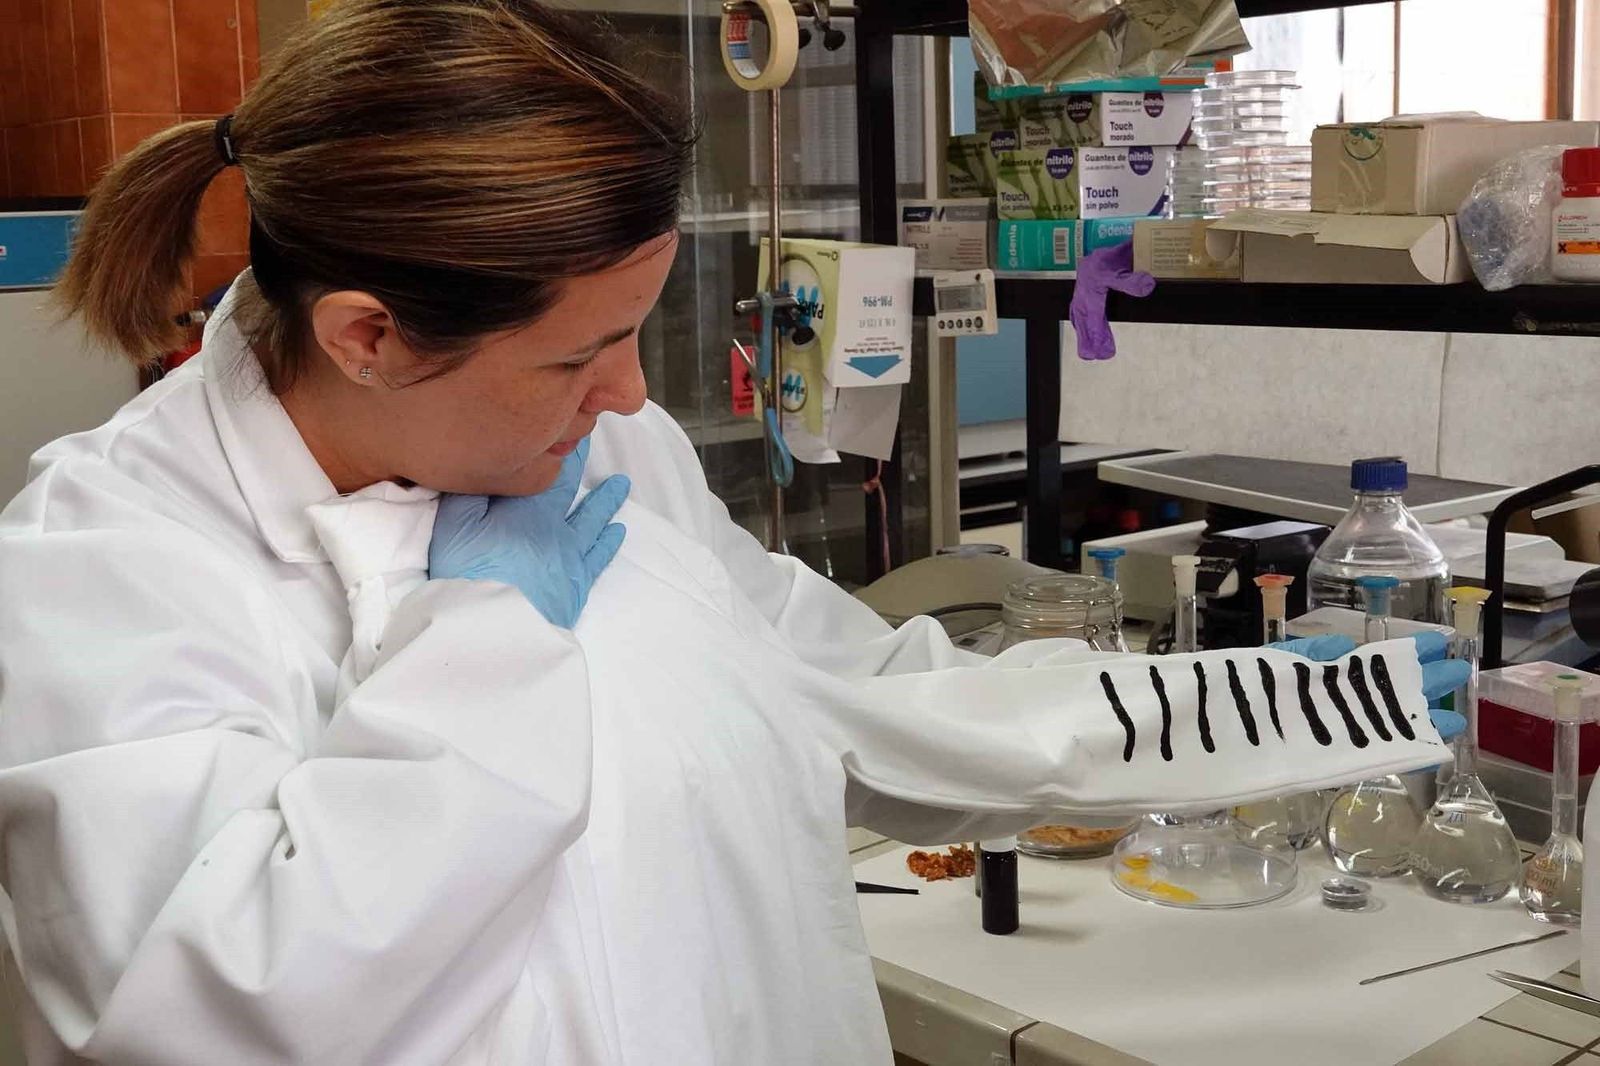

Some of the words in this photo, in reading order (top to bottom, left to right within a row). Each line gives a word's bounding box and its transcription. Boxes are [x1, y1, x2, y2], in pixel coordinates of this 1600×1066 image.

[1110, 121, 1134, 131] Touch
[1110, 133, 1135, 141] morado
[1046, 154, 1074, 165] nitrilo
[1085, 153, 1116, 162] Guantes
[1117, 153, 1126, 161] de
[1128, 151, 1153, 161] nitrilo
[1001, 191, 1030, 201] Touch
[1086, 186, 1119, 198] Touch
[1086, 202, 1097, 210] sin
[1098, 201, 1120, 211] polvo
[861, 294, 893, 309] PM-996
